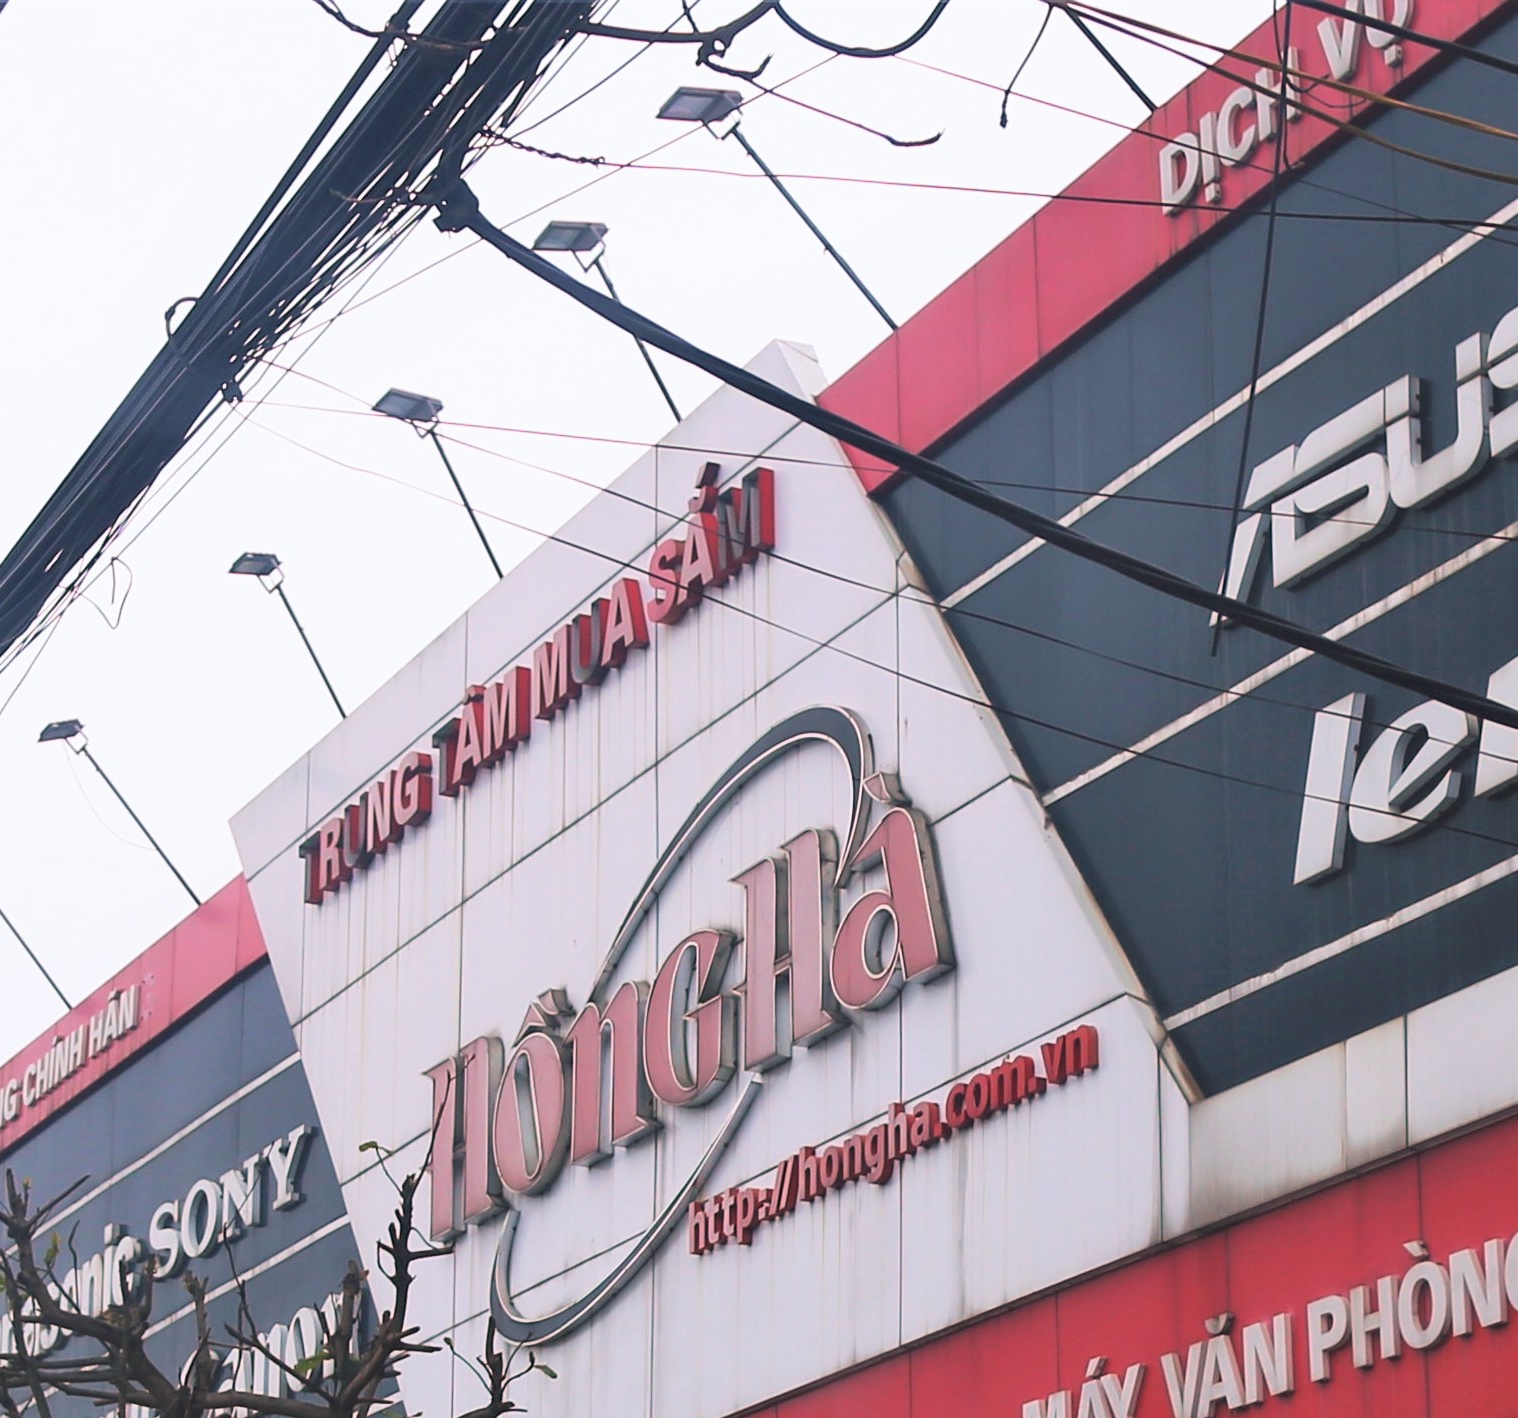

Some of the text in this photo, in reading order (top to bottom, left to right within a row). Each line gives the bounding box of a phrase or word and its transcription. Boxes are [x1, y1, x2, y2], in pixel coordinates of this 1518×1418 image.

[1160, 47, 1302, 216] DỊCH
[299, 462, 775, 905] TRUNG TÂM MUA SẮM
[22, 1024, 88, 1106] CHÍNH
[688, 1024, 1100, 1255] http://hongha.com.vn
[149, 1124, 314, 1279] SONY
